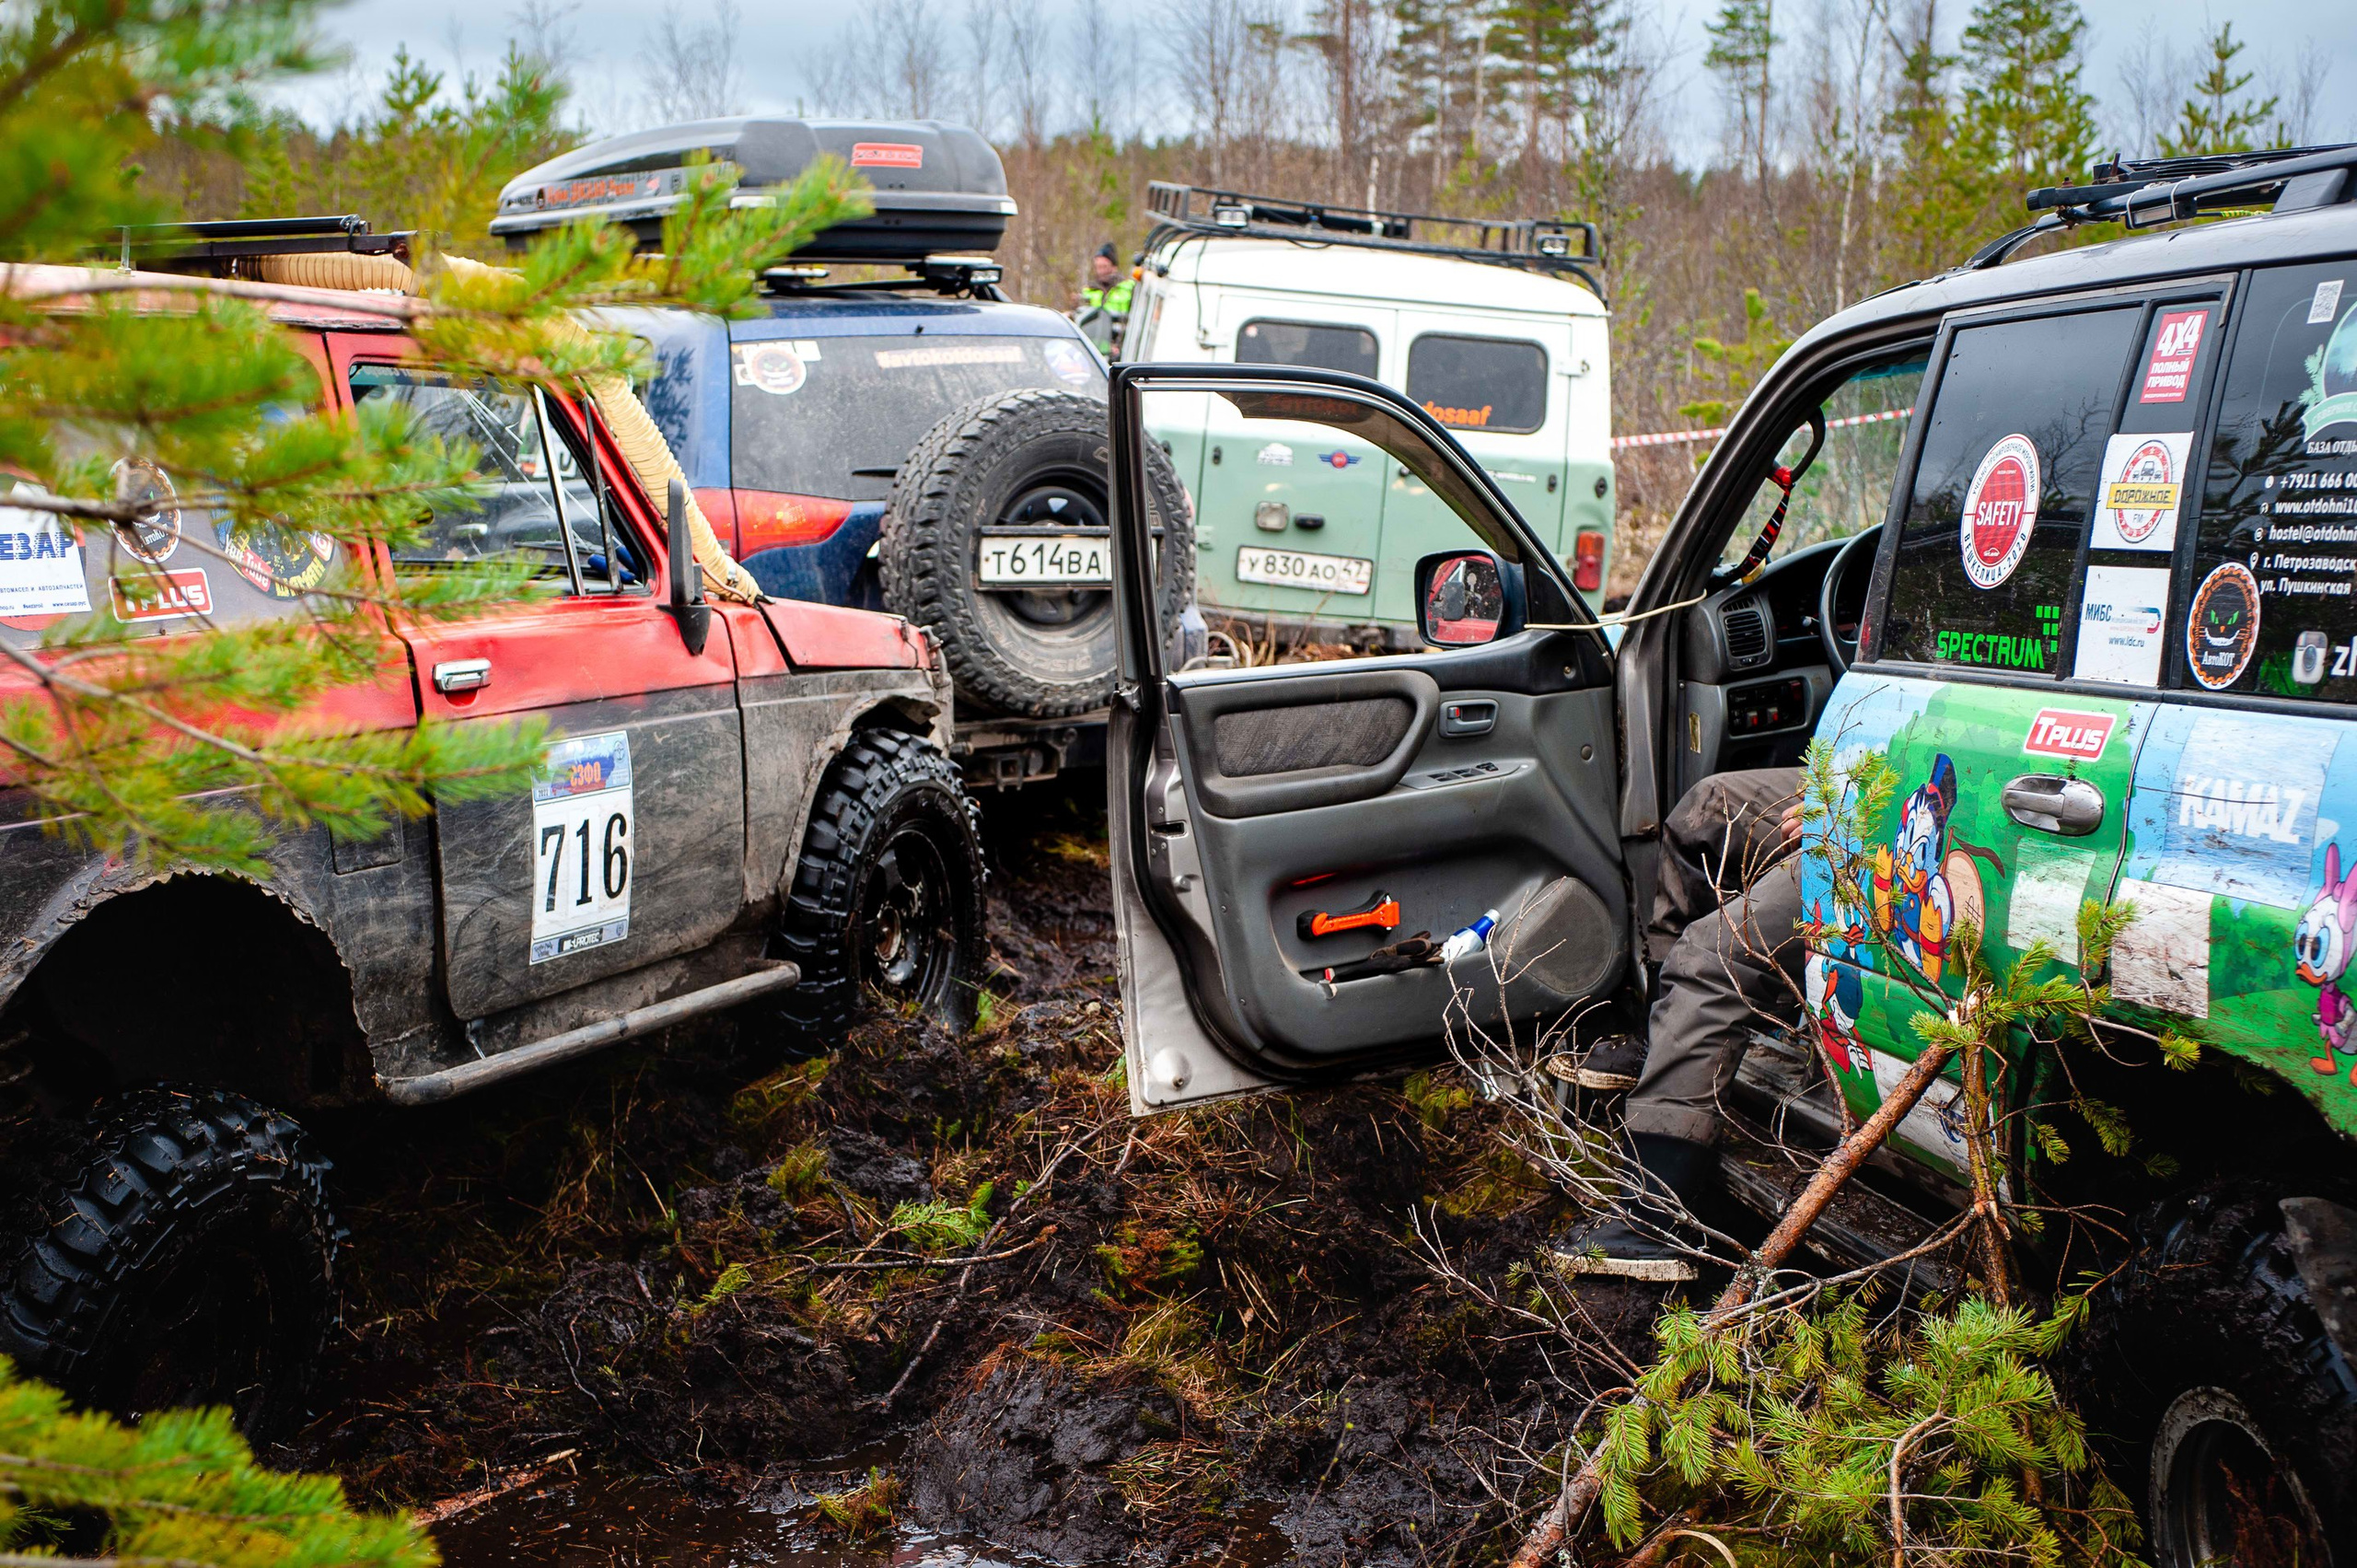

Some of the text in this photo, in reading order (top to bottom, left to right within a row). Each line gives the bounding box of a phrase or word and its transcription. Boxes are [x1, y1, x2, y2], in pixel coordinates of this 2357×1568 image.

[2151, 357, 2190, 374] ПОЛНЫЙ
[2146, 375, 2186, 389] ПРИВОД
[2306, 441, 2330, 454] БАЗА
[2280, 473, 2316, 489] +7911
[2319, 472, 2343, 489] 666
[2114, 489, 2173, 505] ДОРОЖНОЕ
[1976, 500, 2024, 527] SAFETY
[2263, 553, 2357, 573] г. Петрозаводск
[2259, 577, 2352, 597] ул. Пушкинская
[2085, 603, 2113, 622] МИБС
[1935, 630, 2045, 669] SPECTRUM
[2178, 774, 2306, 844] KAMAZ
[540, 812, 628, 913] 716
